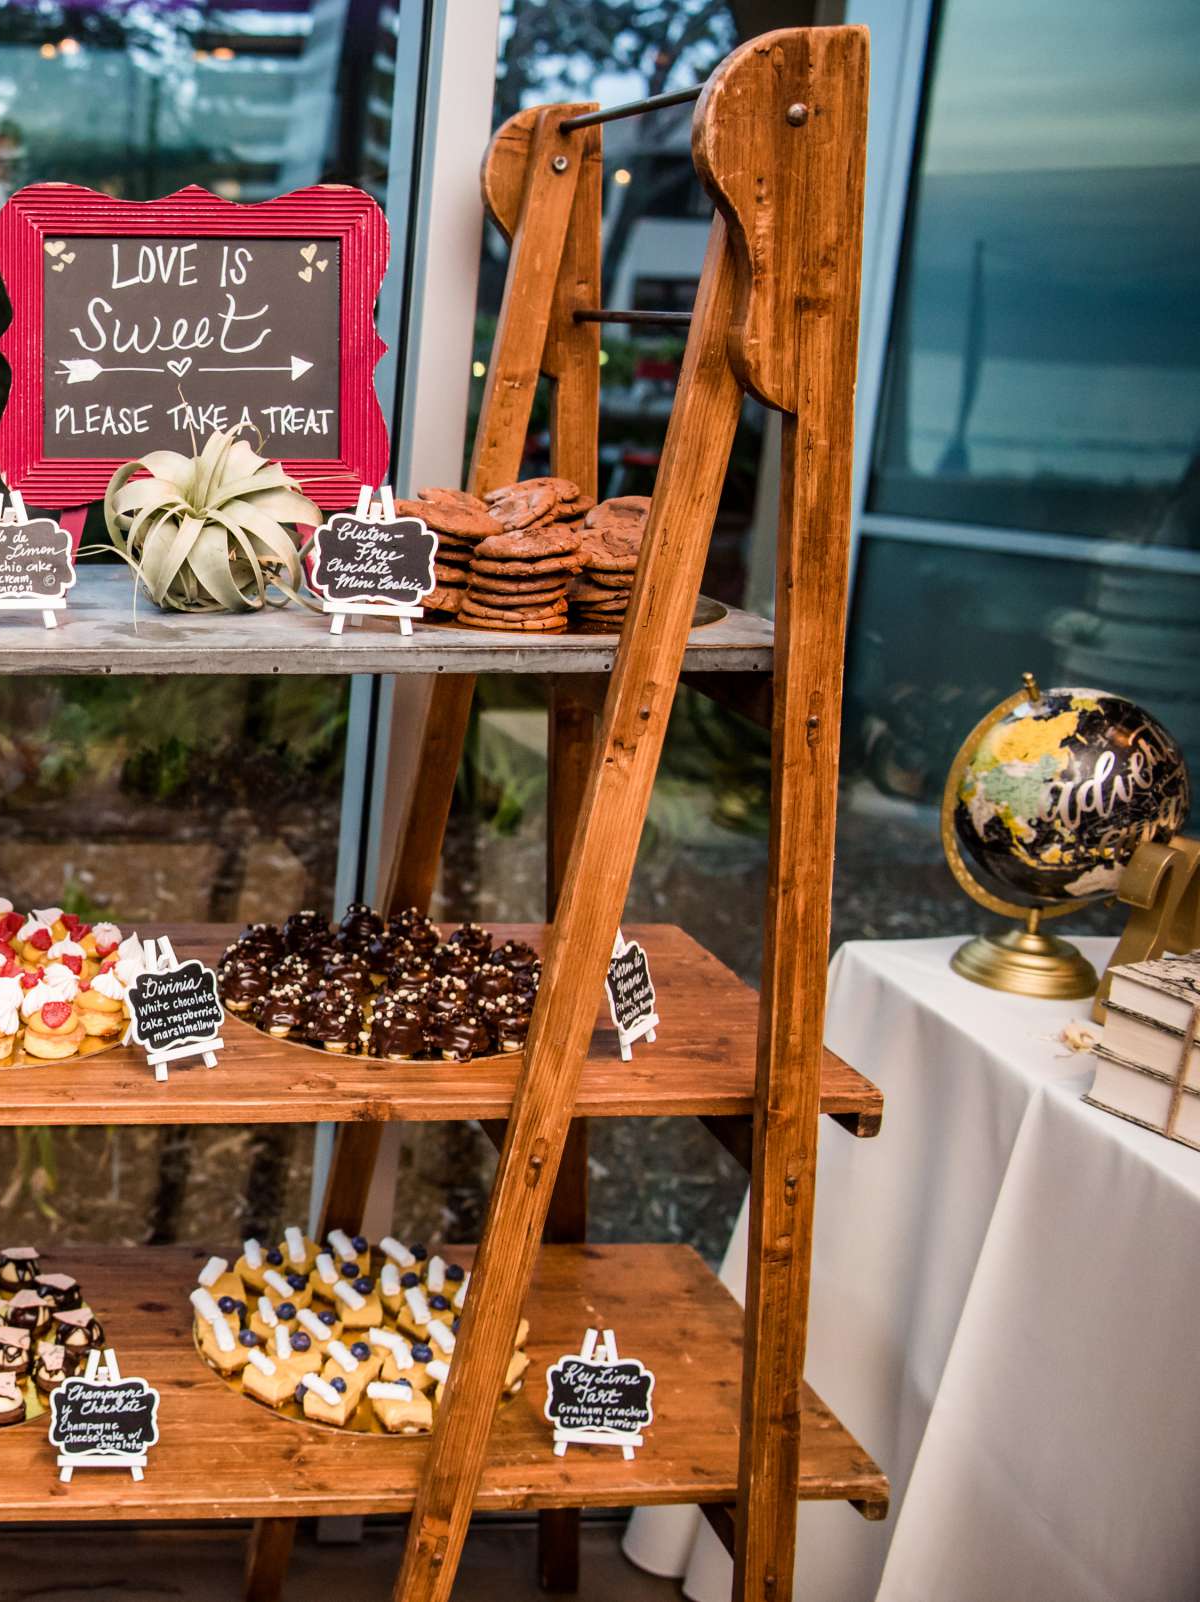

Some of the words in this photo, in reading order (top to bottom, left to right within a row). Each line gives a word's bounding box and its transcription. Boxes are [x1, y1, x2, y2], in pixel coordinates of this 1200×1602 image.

[112, 243, 197, 289] LOVE
[220, 246, 253, 287] IS
[69, 293, 272, 353] Sweet
[55, 404, 153, 435] PLEASE
[166, 402, 228, 435] TAKE
[237, 405, 256, 434] A
[261, 404, 334, 435] TREAT
[13, 530, 29, 543] de
[337, 522, 404, 542] Gluten-
[6, 543, 67, 560] Limon
[354, 541, 404, 560] Free
[26, 560, 56, 573] cake,
[326, 558, 392, 575] Chocolate
[334, 574, 376, 590] Mini
[377, 575, 424, 591] Cookie
[138, 1000, 170, 1017] White
[172, 990, 214, 1009] chocolate
[140, 1018, 167, 1032] cake,
[167, 1005, 221, 1025] raspberries,
[560, 1364, 595, 1388] Key
[595, 1368, 641, 1385] Lime
[67, 1385, 147, 1404] Champagne
[573, 1384, 623, 1404] Tart
[60, 1404, 73, 1421] y
[80, 1398, 147, 1415] Chocolate
[558, 1403, 603, 1416] Graham
[604, 1405, 648, 1418] cracker
[58, 1420, 120, 1436] Champagne
[562, 1415, 593, 1426] crust
[127, 1428, 143, 1440] w/
[96, 1440, 144, 1450] chocolate
